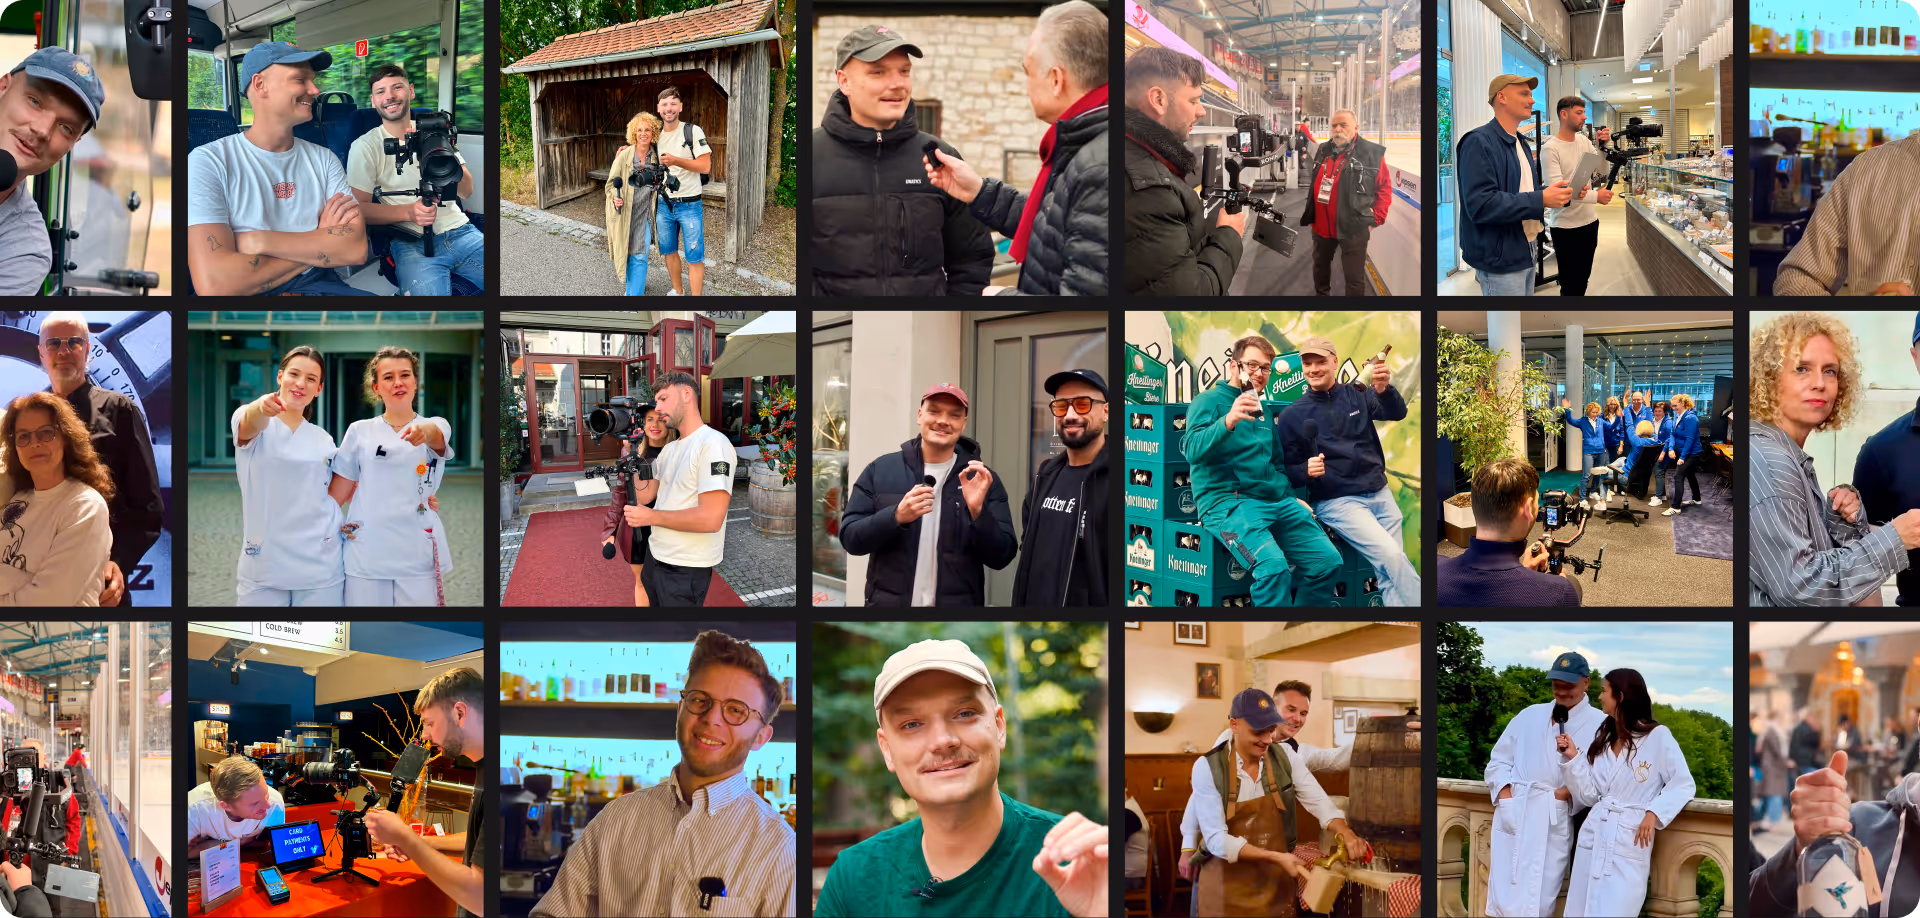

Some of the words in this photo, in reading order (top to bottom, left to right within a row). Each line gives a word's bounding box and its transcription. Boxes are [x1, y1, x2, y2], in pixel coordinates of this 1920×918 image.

[92, 344, 104, 358] 10
[1127, 372, 1163, 390] Kneitinger
[1168, 553, 1208, 577] Kneitinger
[265, 622, 282, 631] COLD
[284, 626, 301, 635] BREW
[211, 705, 229, 713] SHOP
[289, 827, 303, 835] CARD
[284, 836, 311, 846] PAYMENTS
[292, 846, 306, 854] ONLY
